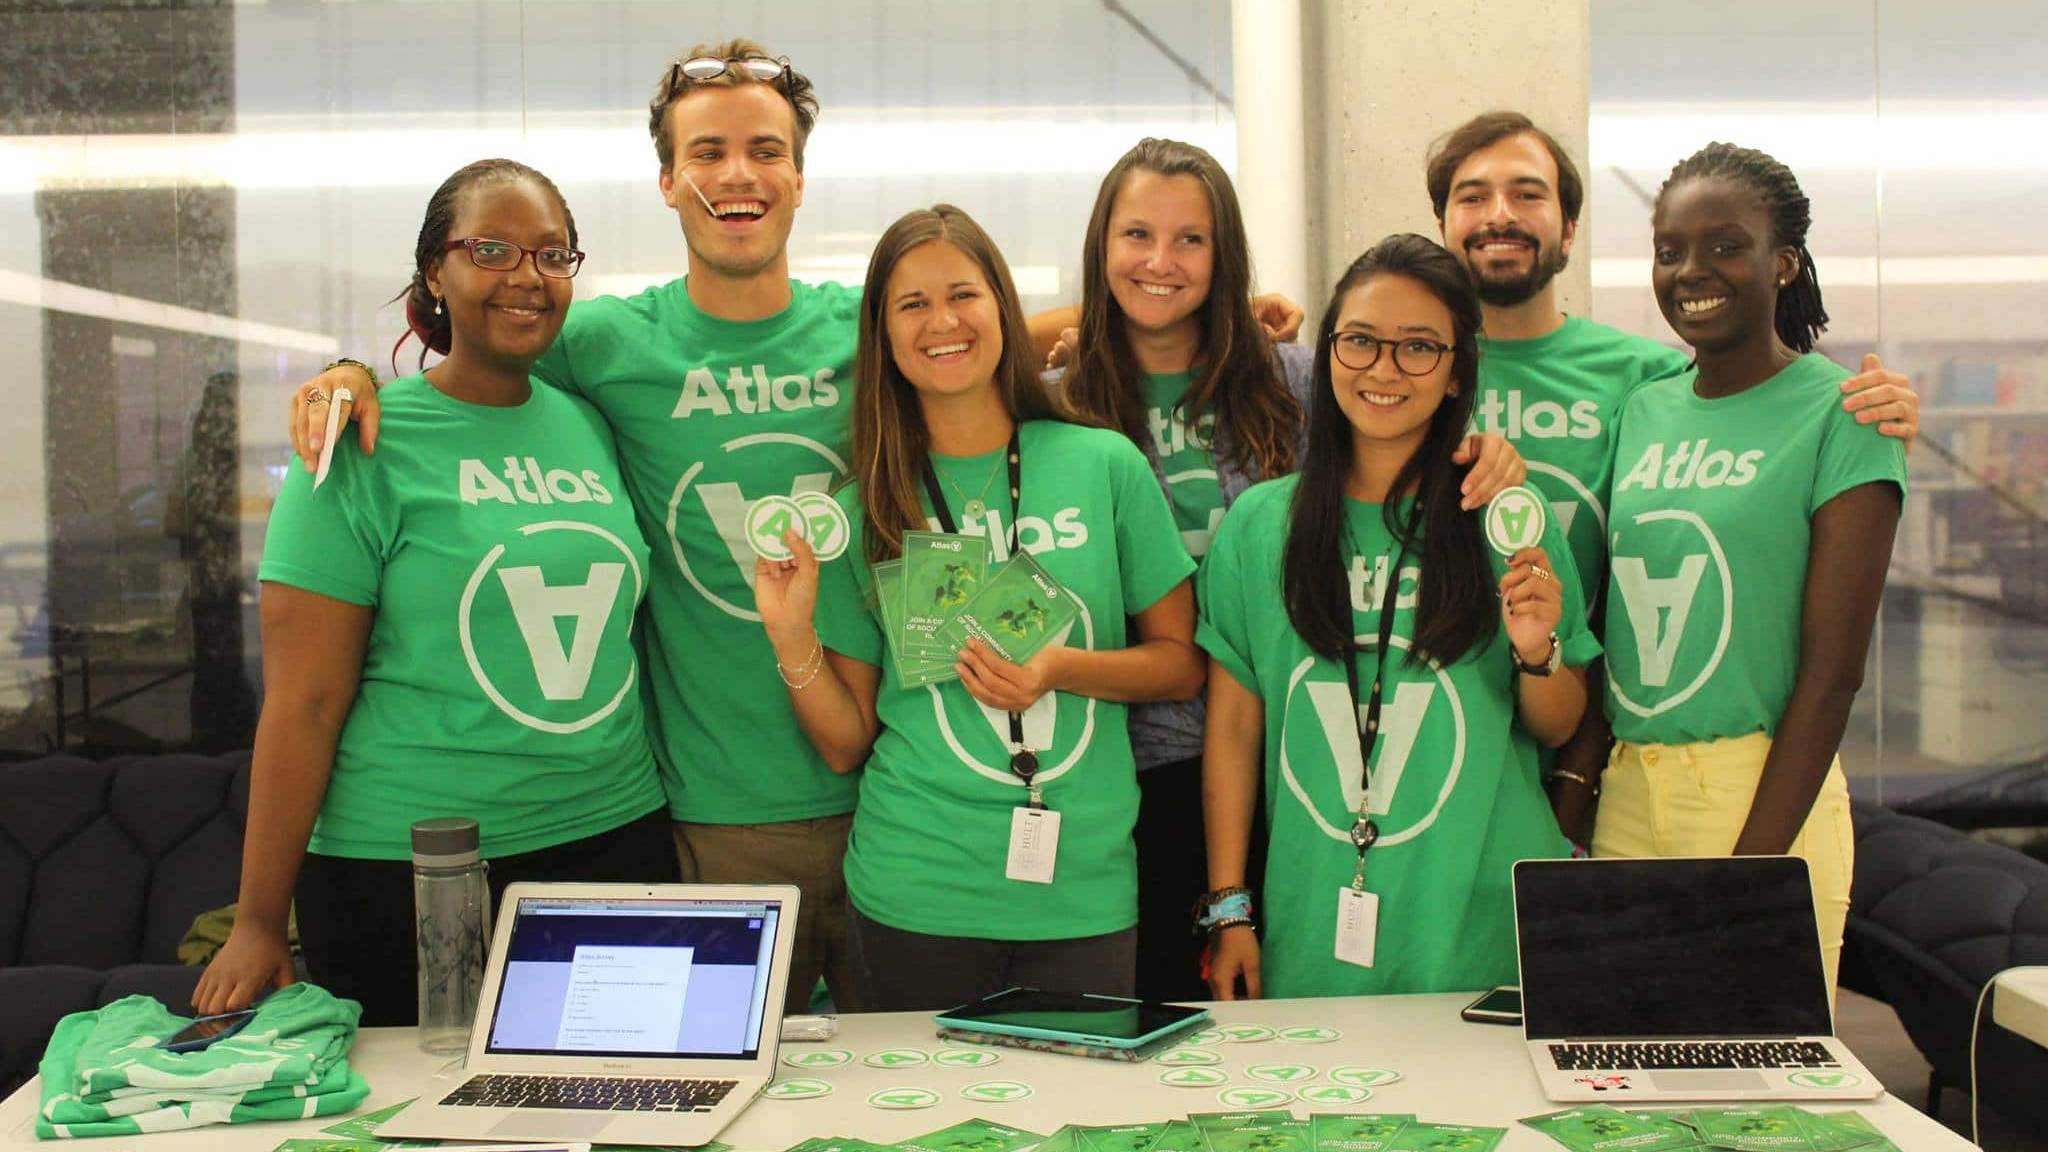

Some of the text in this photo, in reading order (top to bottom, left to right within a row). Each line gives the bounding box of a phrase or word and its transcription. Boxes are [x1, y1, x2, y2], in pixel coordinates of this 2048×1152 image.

[672, 364, 839, 418] Atlas
[1467, 389, 1601, 439] tlas
[459, 456, 613, 505] Atlas
[1616, 438, 1765, 491] Atlas
